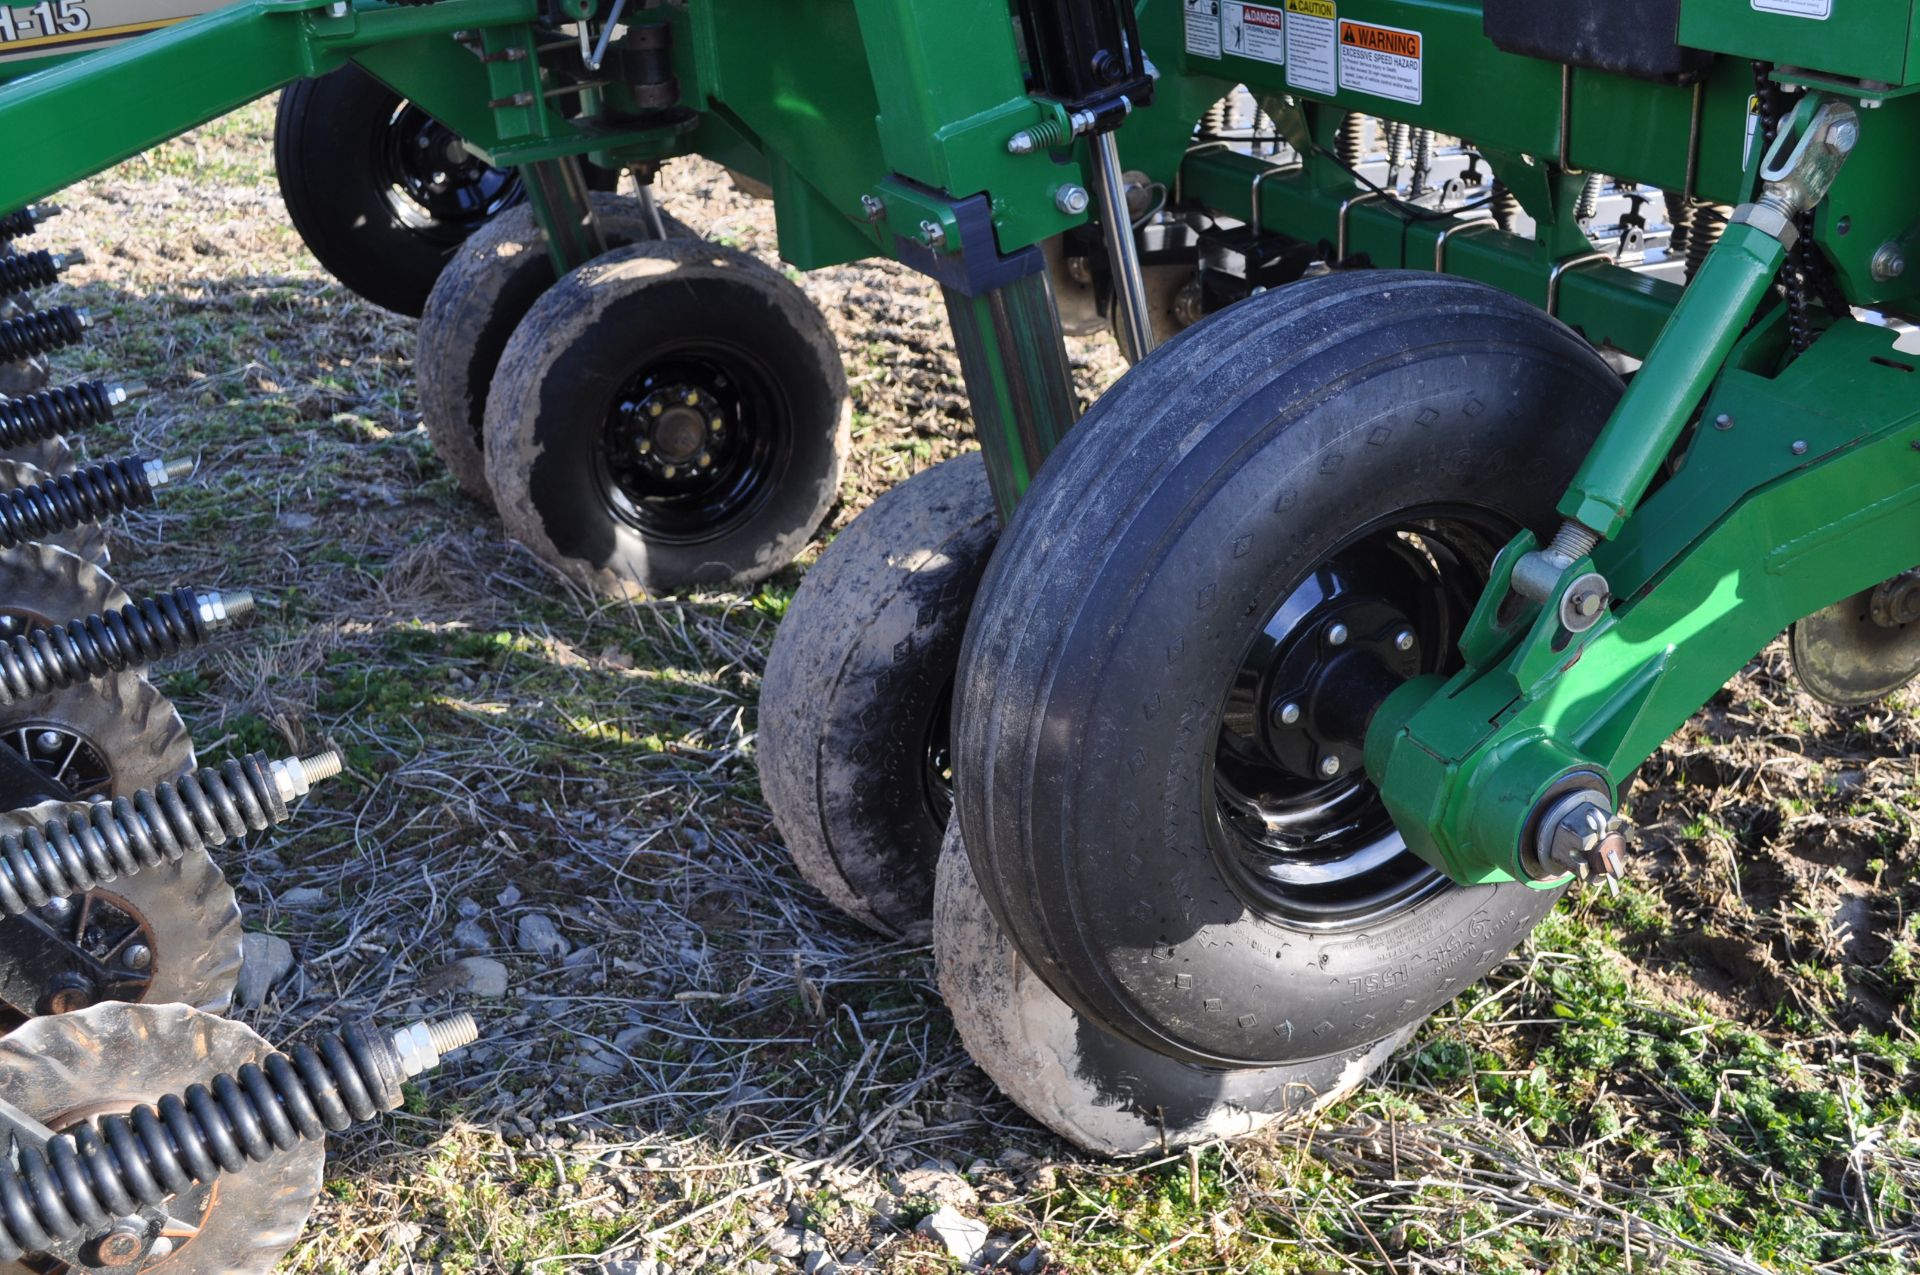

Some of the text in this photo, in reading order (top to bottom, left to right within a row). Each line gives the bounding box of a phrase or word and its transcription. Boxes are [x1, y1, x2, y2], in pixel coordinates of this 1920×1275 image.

[1250, 9, 1280, 26] DANGER
[1298, 0, 1332, 16] CAUTION
[1358, 27, 1416, 55] WARNING
[1342, 47, 1372, 61] EXCESSIVE
[1373, 53, 1392, 65] SPEED
[1393, 57, 1417, 70] HAZARD
